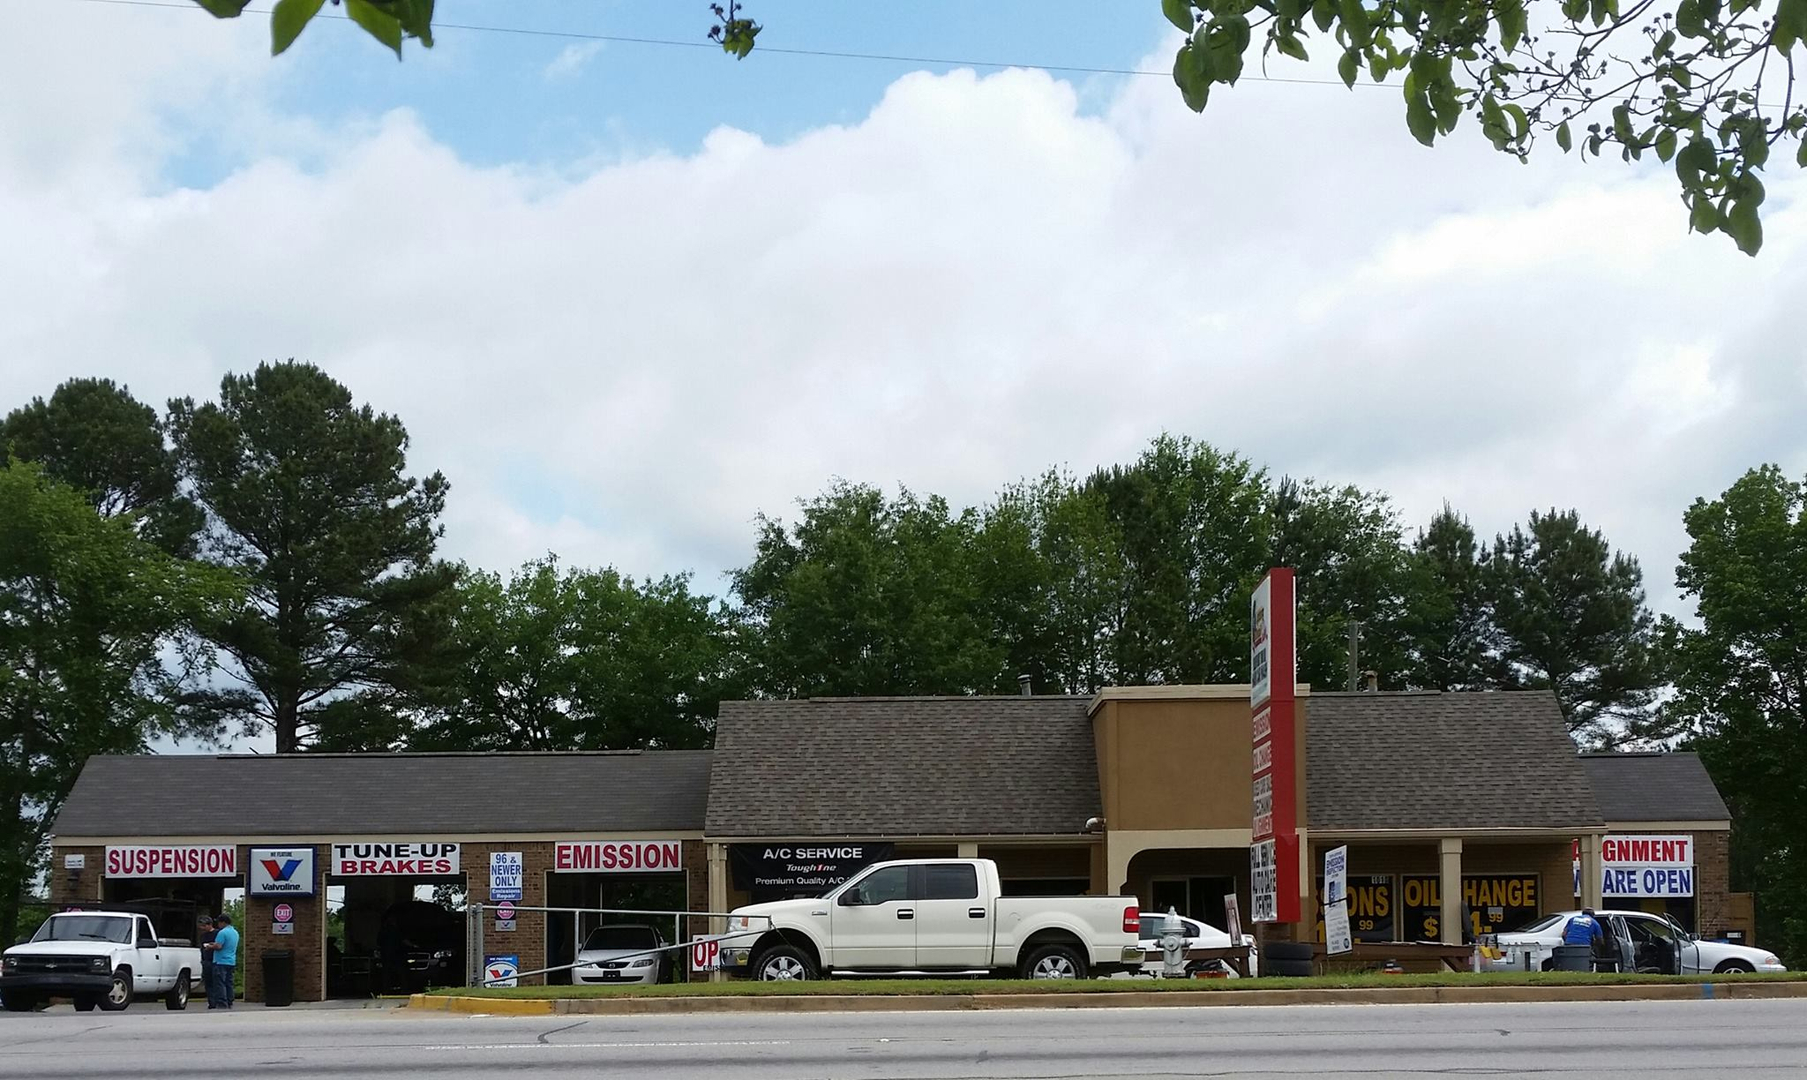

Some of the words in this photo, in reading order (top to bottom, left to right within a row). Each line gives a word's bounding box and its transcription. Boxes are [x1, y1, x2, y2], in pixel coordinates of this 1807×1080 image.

[334, 843, 457, 859] TUNE-UP
[557, 844, 679, 869] EMISSION
[763, 848, 791, 860] A/C
[796, 847, 863, 859] SERVICE
[108, 849, 235, 875] SUSPENSION
[495, 853, 507, 864] 96
[510, 856, 517, 864] &
[341, 859, 452, 874] BRAKES
[491, 864, 522, 875] NEWER
[262, 883, 302, 891] Valvoline
[495, 875, 518, 887] ONLY
[755, 877, 794, 885] Premium
[796, 876, 827, 887] Quality
[828, 876, 845, 885] A/C
[1602, 869, 1638, 894] ARE
[1643, 869, 1691, 894] OPEN
[1405, 879, 1440, 907] OIL
[1463, 879, 1536, 907] HANGE
[276, 908, 290, 917] EXIT
[1359, 919, 1374, 931] 99
[694, 938, 719, 968] OP
